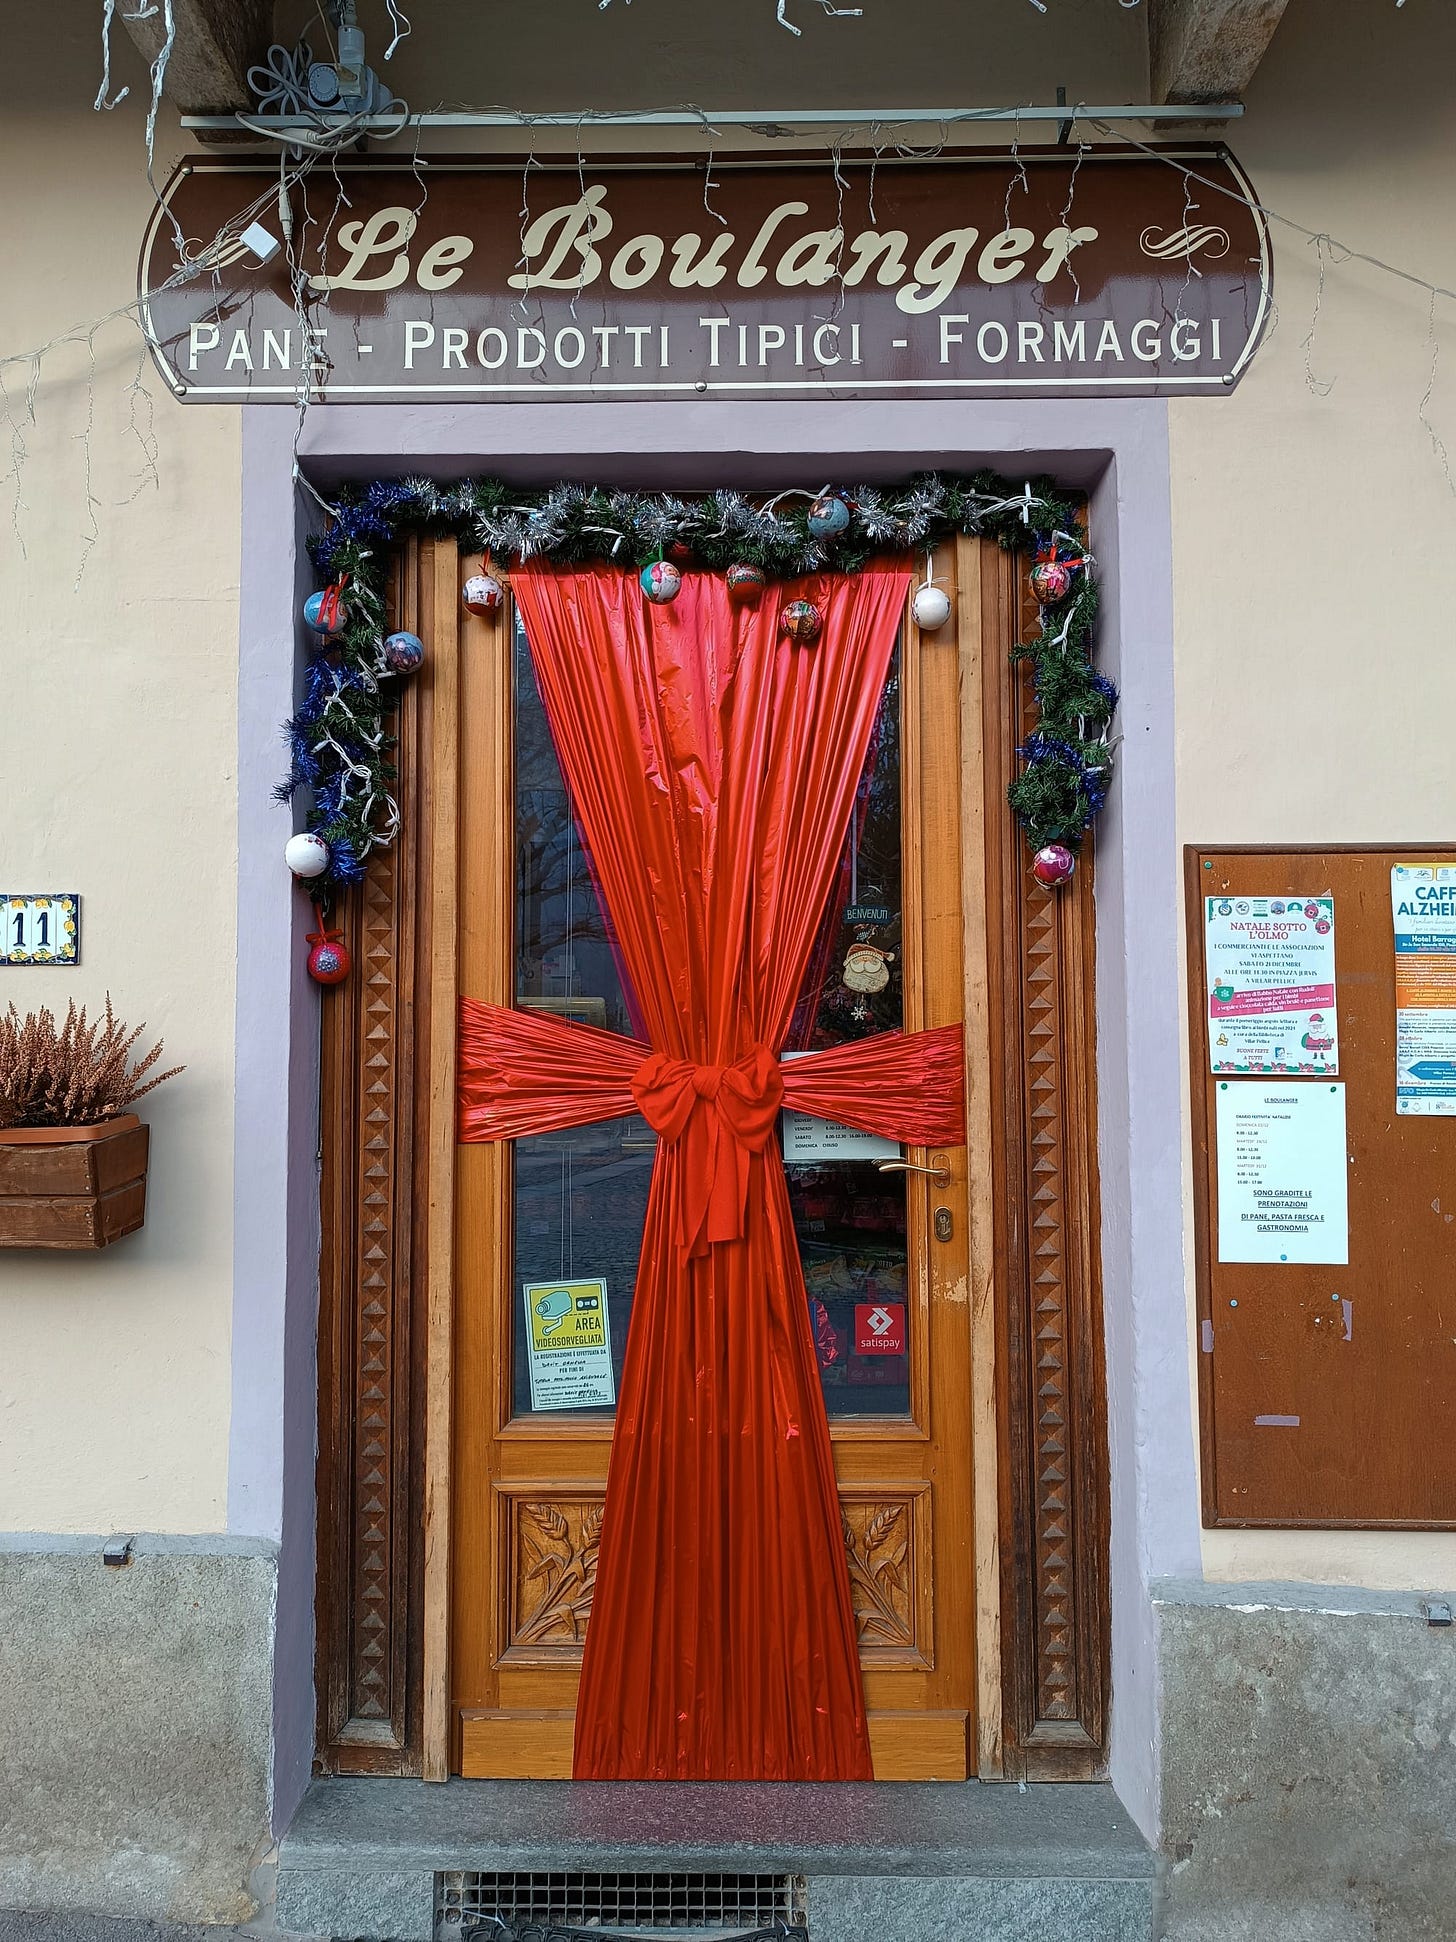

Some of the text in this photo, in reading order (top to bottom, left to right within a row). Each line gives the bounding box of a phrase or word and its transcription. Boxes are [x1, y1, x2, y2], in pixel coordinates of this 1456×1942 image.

[309, 184, 1099, 314] Le Boulanger
[188, 322, 329, 370] PANE
[404, 321, 670, 370] PRODOTTI
[699, 317, 863, 367] TIPICI
[938, 314, 1223, 364] FORMAGGI
[846, 908, 888, 920] BENVENUTI
[1397, 902, 1456, 916] ALZHEI
[12, 911, 51, 947] 11
[1230, 922, 1307, 931] NATALE SOTTO
[1249, 931, 1289, 940] L'OLMO
[1411, 935, 1431, 943] Hotel
[1274, 1189, 1303, 1197] GRADITE
[1257, 1200, 1308, 1208] PRENOTAZIONI
[1249, 1213, 1270, 1221] PANE,
[575, 1316, 601, 1331] AREA
[535, 1334, 603, 1348] VIDEOSORVEGLIATA
[860, 1338, 900, 1350] satispay
[540, 1351, 573, 1360] REGISTRAZIONE
